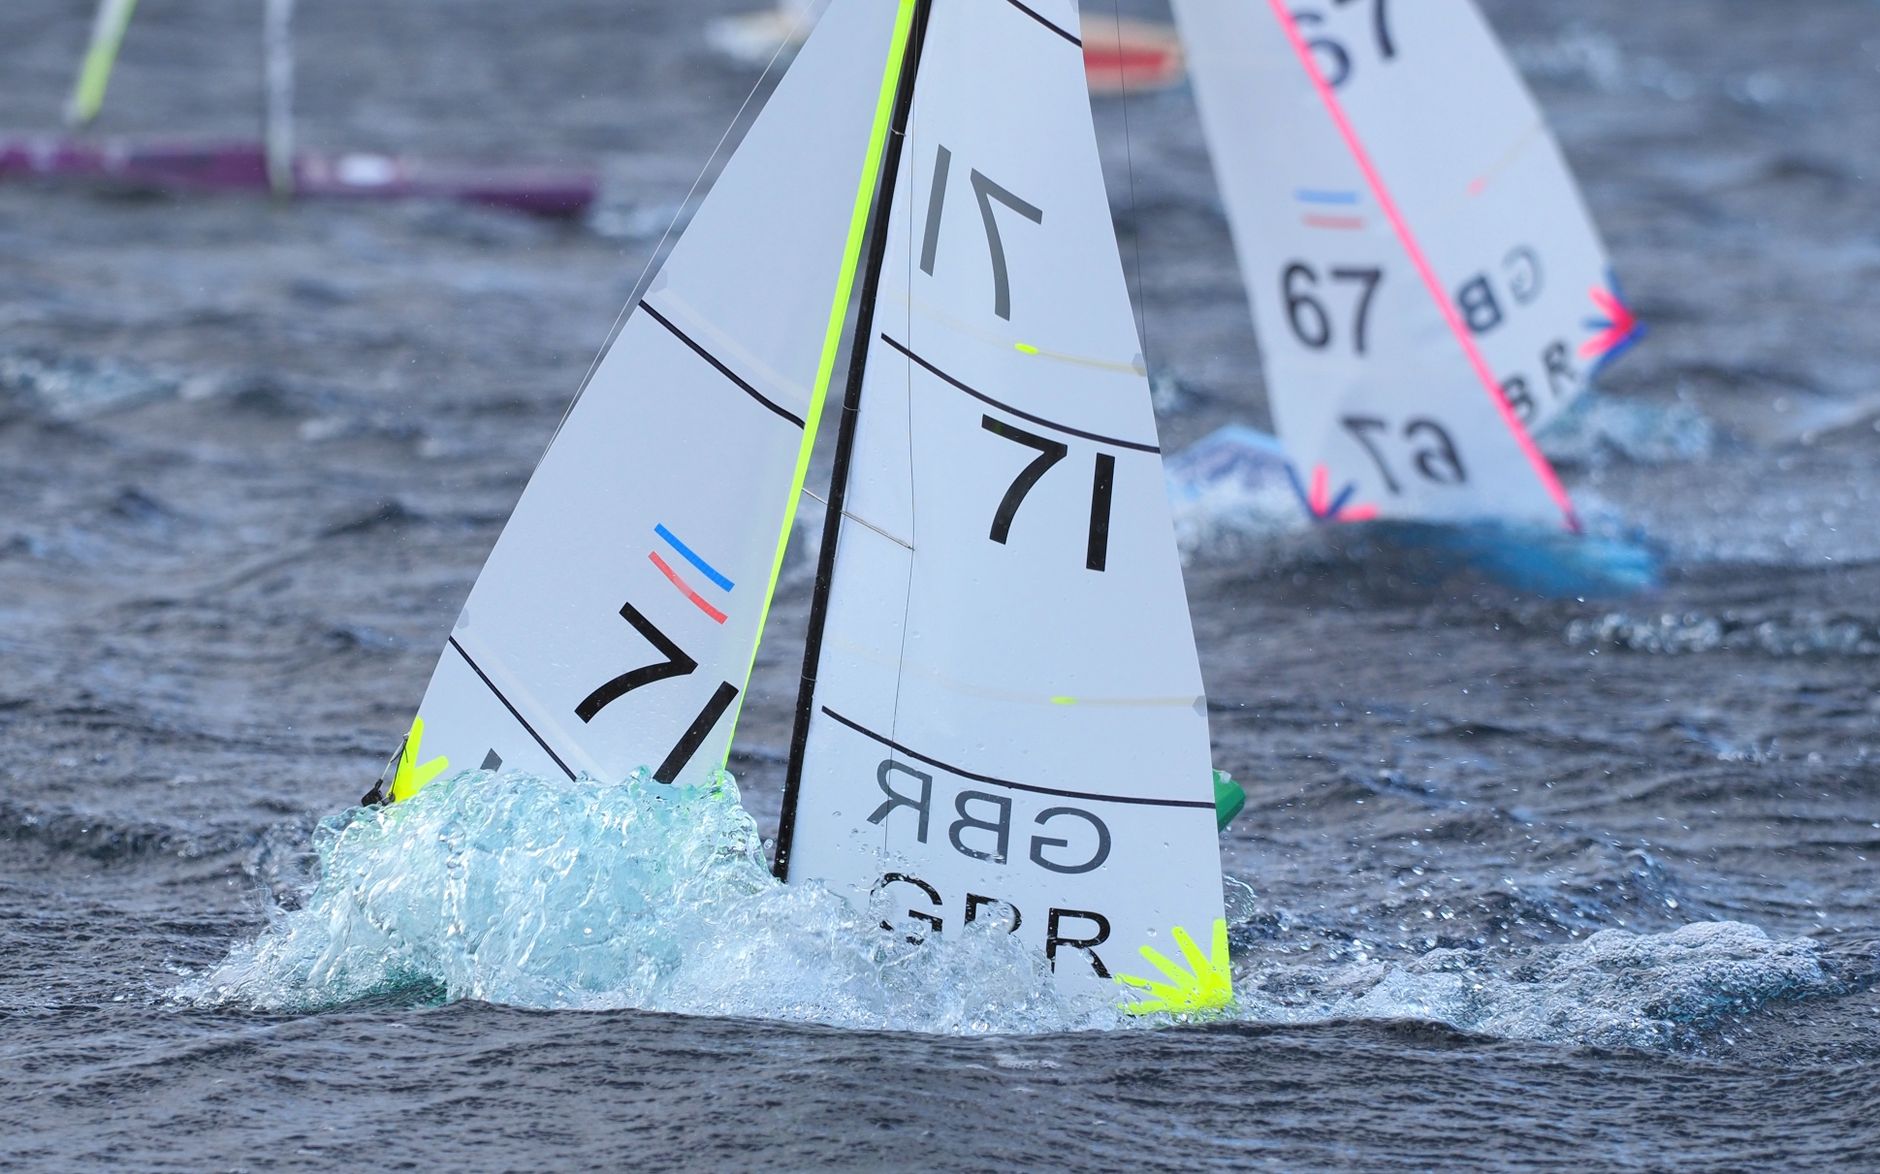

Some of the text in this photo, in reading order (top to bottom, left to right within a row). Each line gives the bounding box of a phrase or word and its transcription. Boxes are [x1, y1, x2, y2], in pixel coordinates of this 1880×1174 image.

[1280, 258, 1385, 357] 67
[981, 413, 1116, 572] 71
[574, 602, 740, 784] 71
